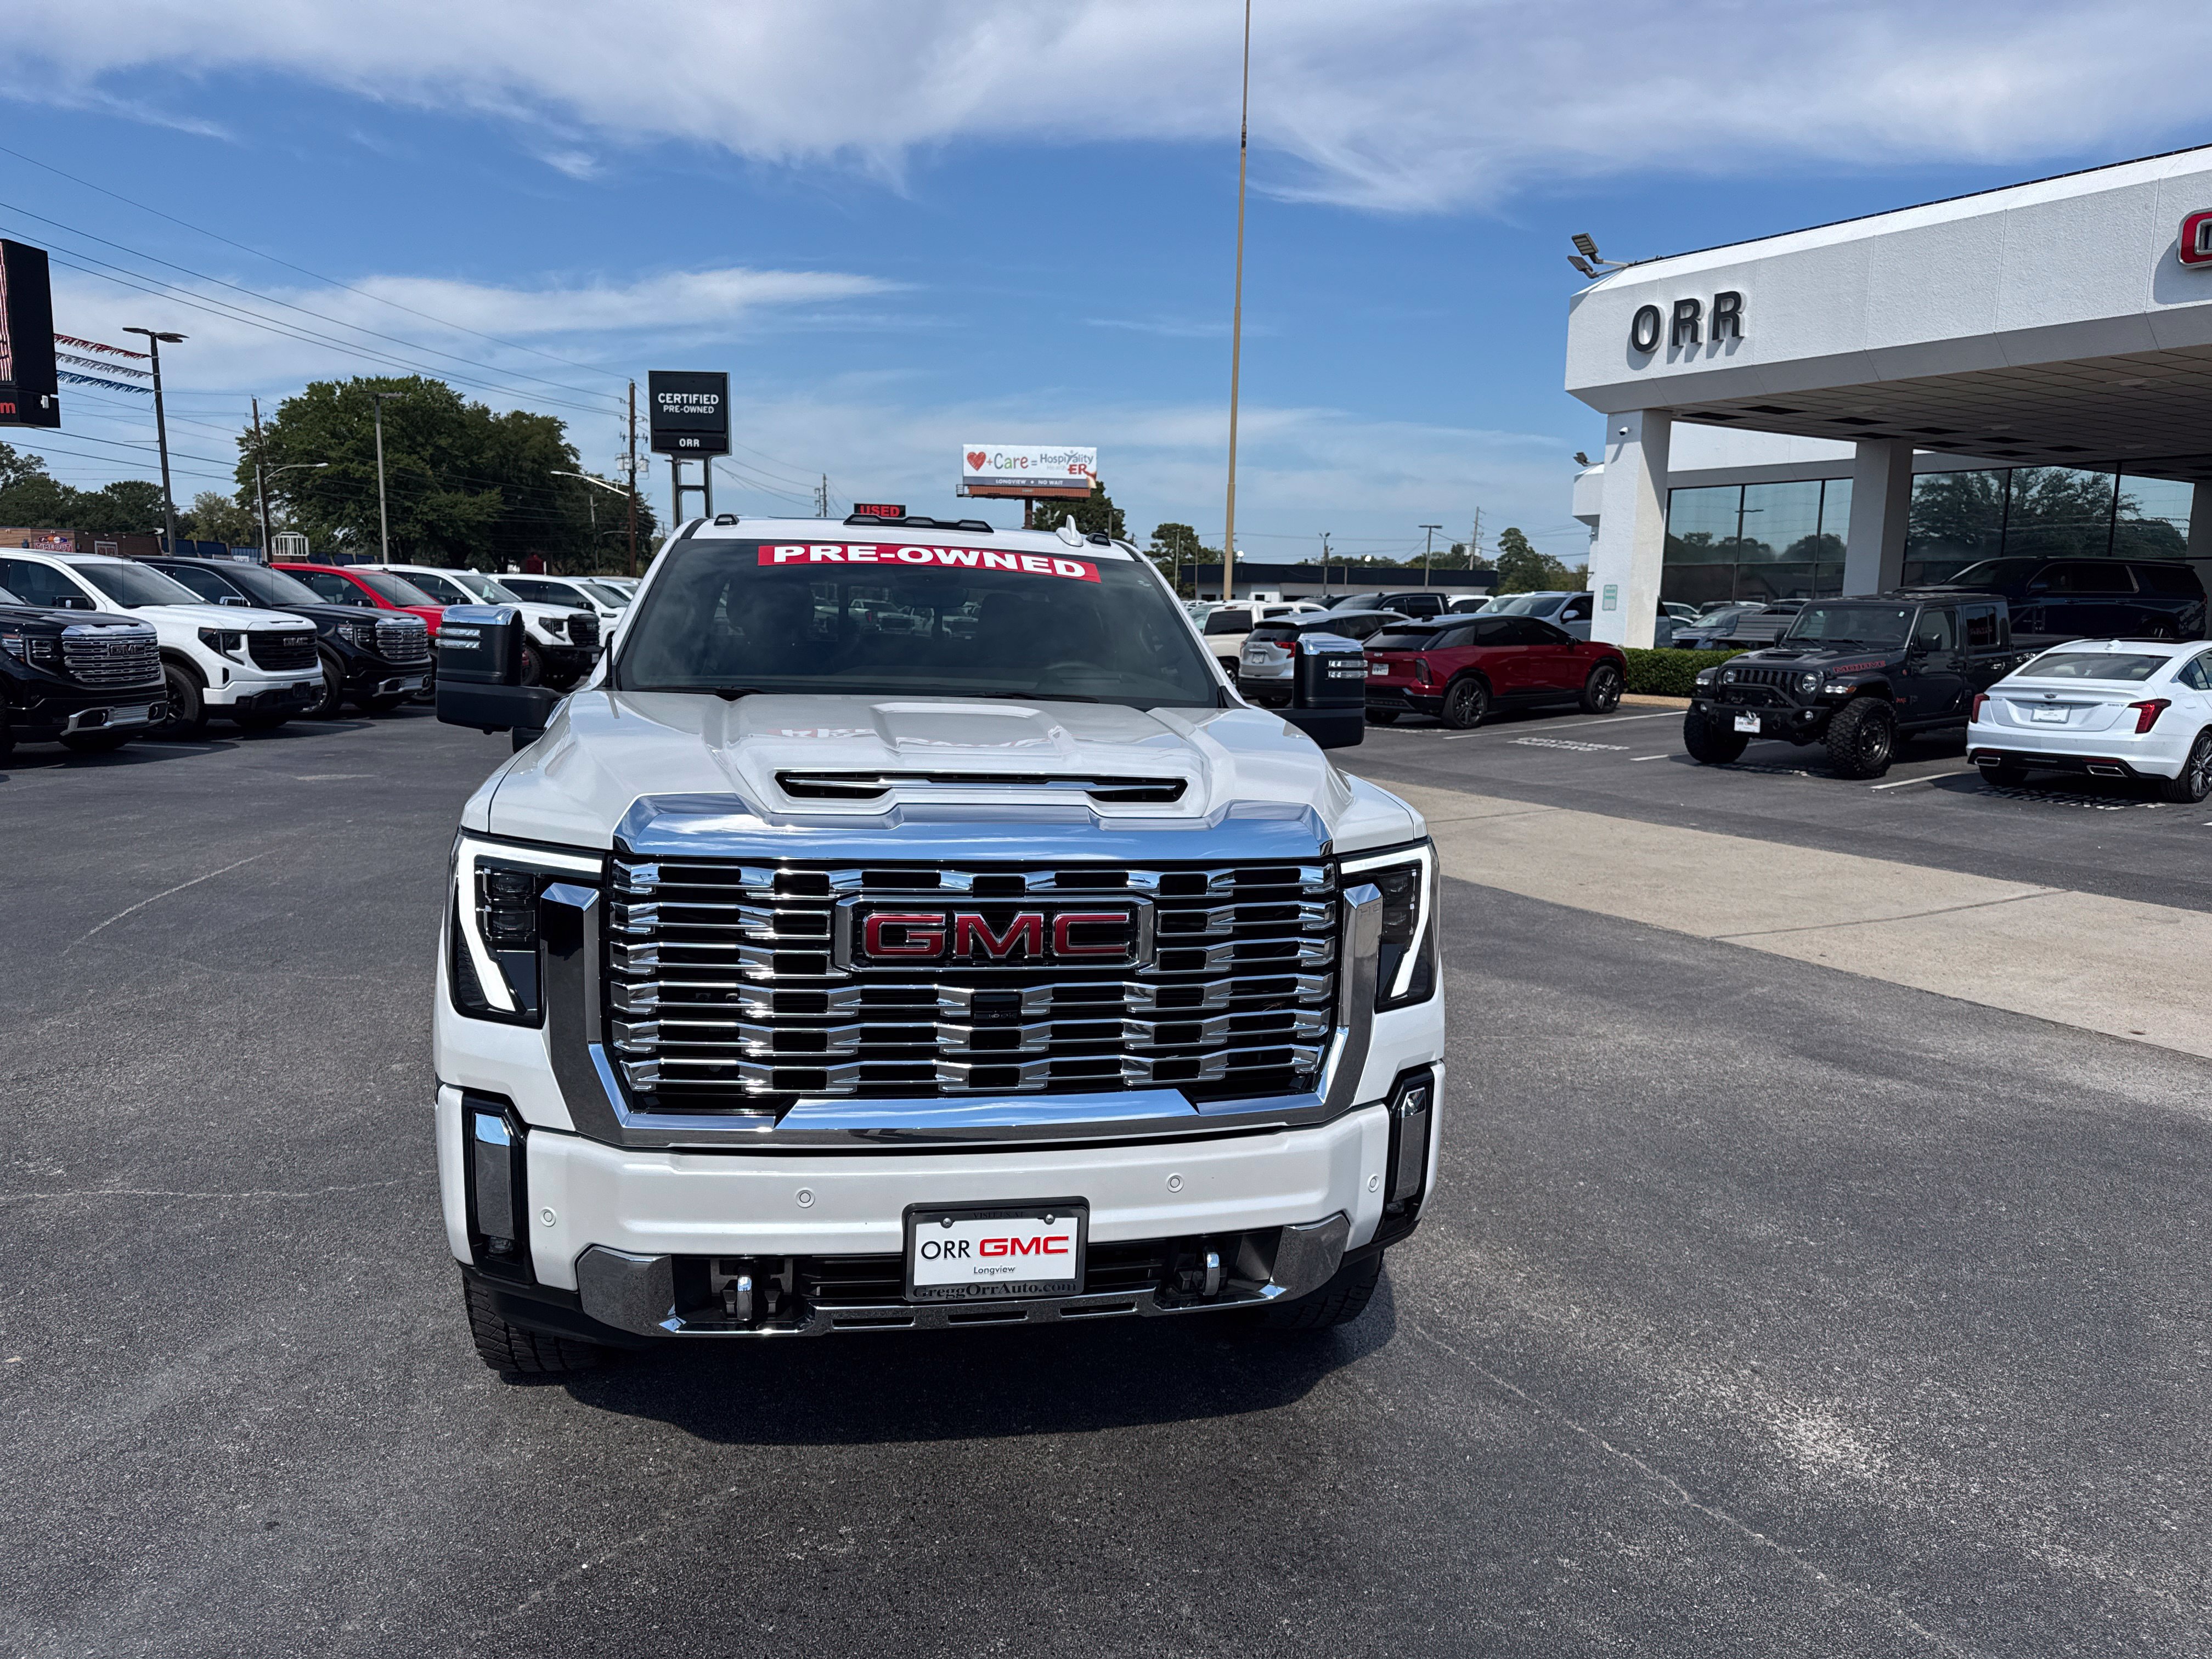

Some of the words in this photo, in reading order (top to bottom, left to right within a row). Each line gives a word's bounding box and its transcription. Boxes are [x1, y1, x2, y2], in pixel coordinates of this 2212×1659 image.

[1632, 291, 1746, 352] ORR
[658, 393, 719, 404] CERTIFIED
[663, 405, 715, 414] PRE-OWNED
[679, 438, 700, 448] ORR
[994, 453, 1029, 469] Care
[860, 505, 900, 517] USED
[774, 545, 1086, 577] PRE-OWNED
[283, 637, 308, 647] GMC
[110, 645, 145, 655] GMC
[1833, 661, 1886, 674] MOJAVE
[863, 911, 1131, 959] GMC
[921, 1240, 971, 1260] ORR
[979, 1235, 1069, 1257] GMC
[973, 1265, 1016, 1275] Longview
[912, 1282, 1077, 1299] GreggOrrAuto.com
